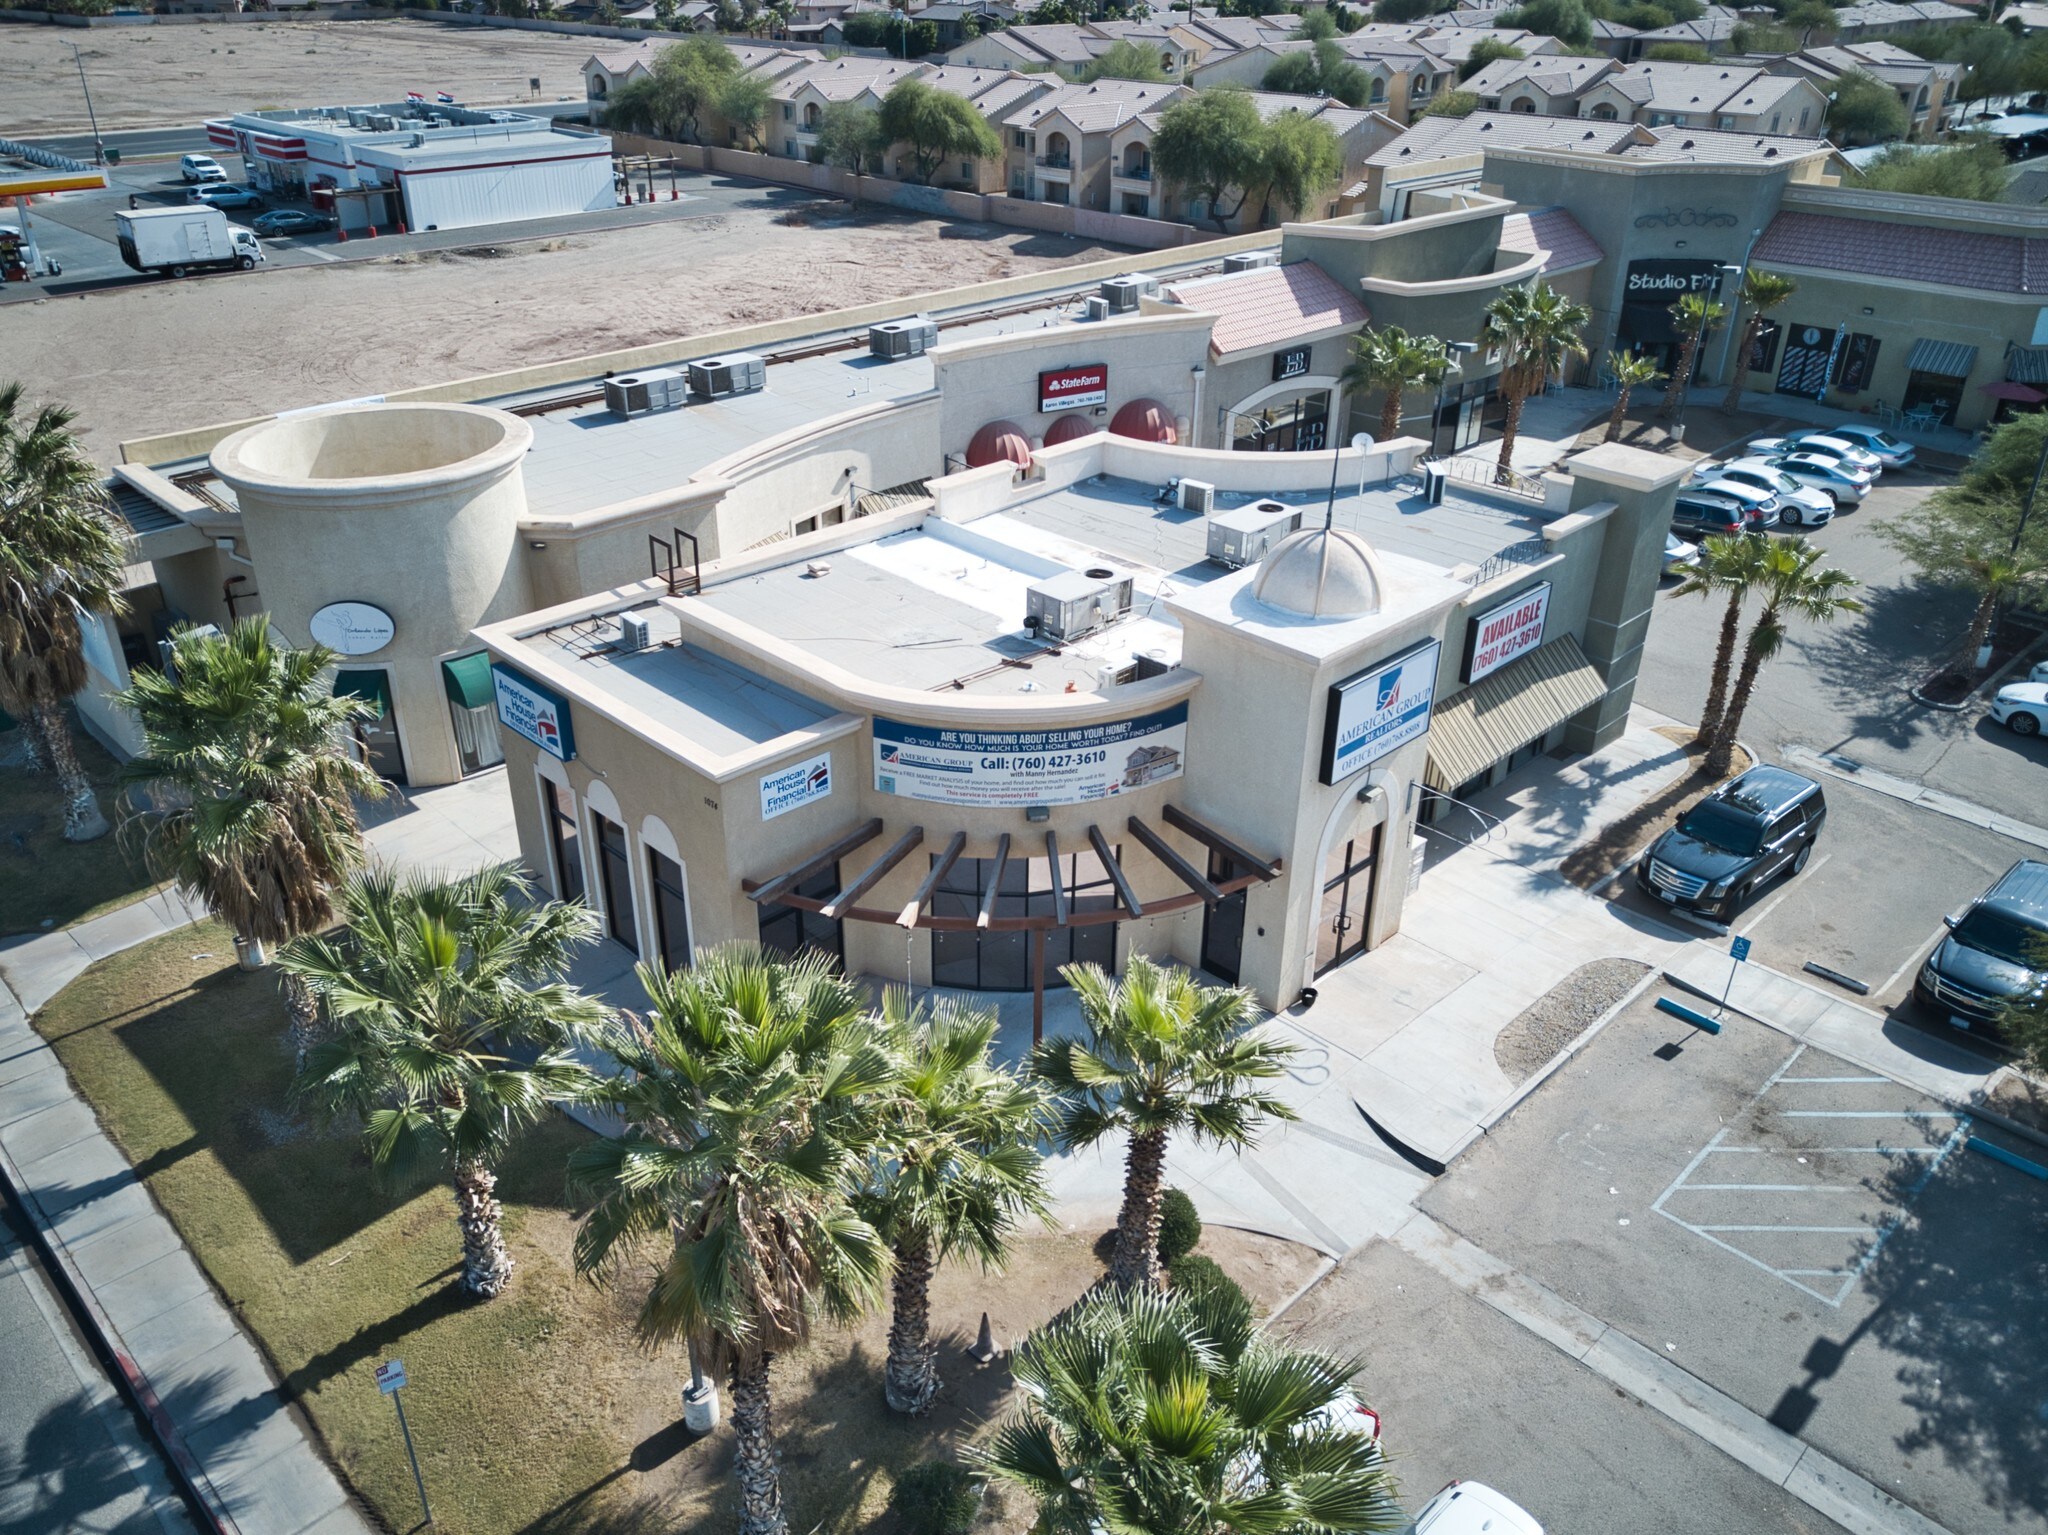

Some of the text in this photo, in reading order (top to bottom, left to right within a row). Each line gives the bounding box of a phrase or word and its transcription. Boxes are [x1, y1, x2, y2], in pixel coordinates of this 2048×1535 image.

[1629, 273, 1686, 290] Studio
[1481, 598, 1542, 649] AVAILABLE
[1473, 622, 1541, 673] (760) 427-3610
[498, 679, 535, 710] American
[505, 705, 538, 735] Financial
[511, 698, 536, 723] House
[1339, 687, 1431, 745] AMERICAN GROUP
[904, 736, 916, 744] DO
[918, 738, 935, 748] YOU
[936, 741, 962, 750] KNOW
[964, 743, 984, 751] HOW
[987, 744, 1010, 752] MUCH
[1012, 744, 1020, 752] IS
[1021, 744, 1043, 752] YOUR
[1045, 743, 1069, 751] HOME
[1071, 739, 1100, 748] WORTH
[1101, 733, 1128, 744] TODAY?
[1129, 729, 1145, 738] FIND
[940, 722, 1132, 745] ARE YOU THINKING ABOUT SELLING YOUR HOME?
[1365, 716, 1404, 744] REALTORS
[900, 752, 941, 763] AMERICAN
[944, 758, 973, 767] GROUP
[981, 757, 1010, 769] Call:
[1012, 757, 1046, 771] (760)
[1048, 750, 1106, 768] 427-3610
[1341, 746, 1373, 772] OFFICE
[763, 769, 806, 791] American
[916, 773, 938, 781] MARKET
[1025, 770, 1046, 778] Manny
[1047, 768, 1078, 776] Hernandez
[767, 785, 807, 807] Financial
[777, 777, 806, 793] House
[765, 801, 789, 814] OFFICE
[377, 1366, 387, 1376] NO
[380, 1371, 403, 1384] PARKING
